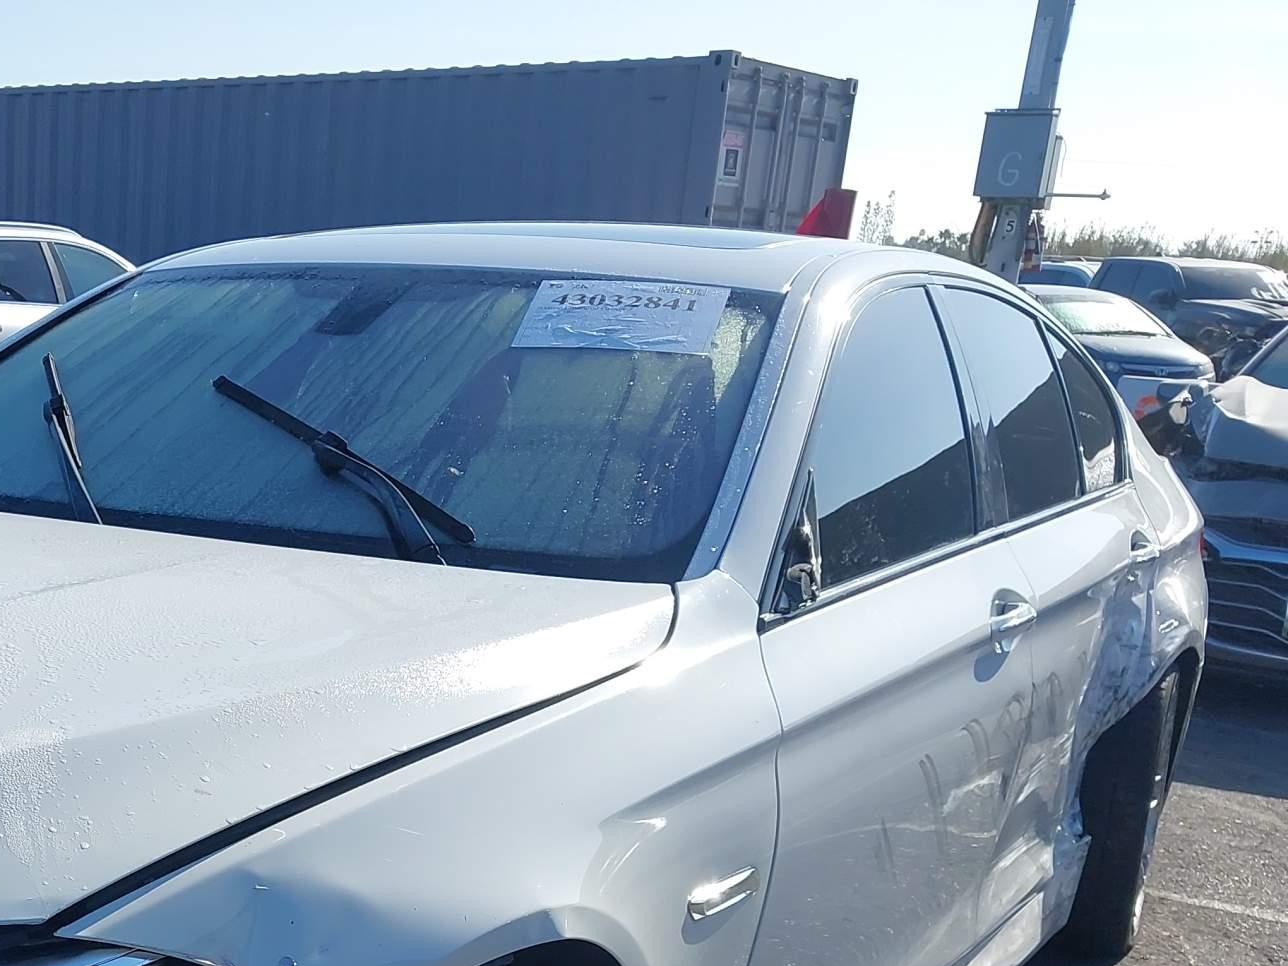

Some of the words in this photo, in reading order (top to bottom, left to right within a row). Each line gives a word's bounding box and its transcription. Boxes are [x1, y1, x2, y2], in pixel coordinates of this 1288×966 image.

[997, 151, 1023, 187] G
[1005, 220, 1015, 233] 5
[551, 293, 697, 312] 43032841
